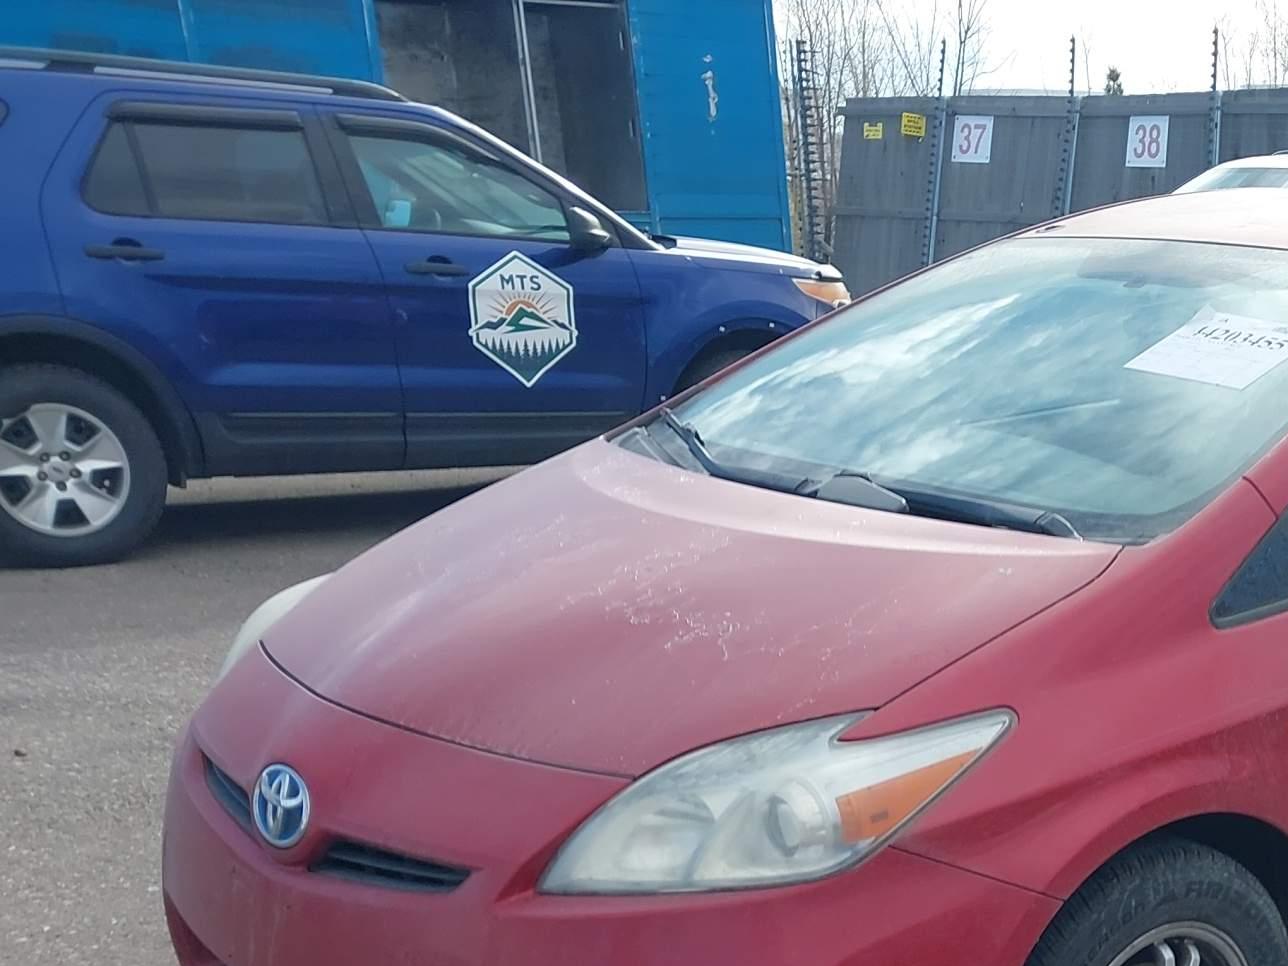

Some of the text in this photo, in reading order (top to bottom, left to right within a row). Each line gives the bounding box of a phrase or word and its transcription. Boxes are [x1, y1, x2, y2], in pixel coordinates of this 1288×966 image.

[959, 123, 987, 155] 37
[1133, 123, 1161, 159] 38
[499, 273, 542, 292] MTS
